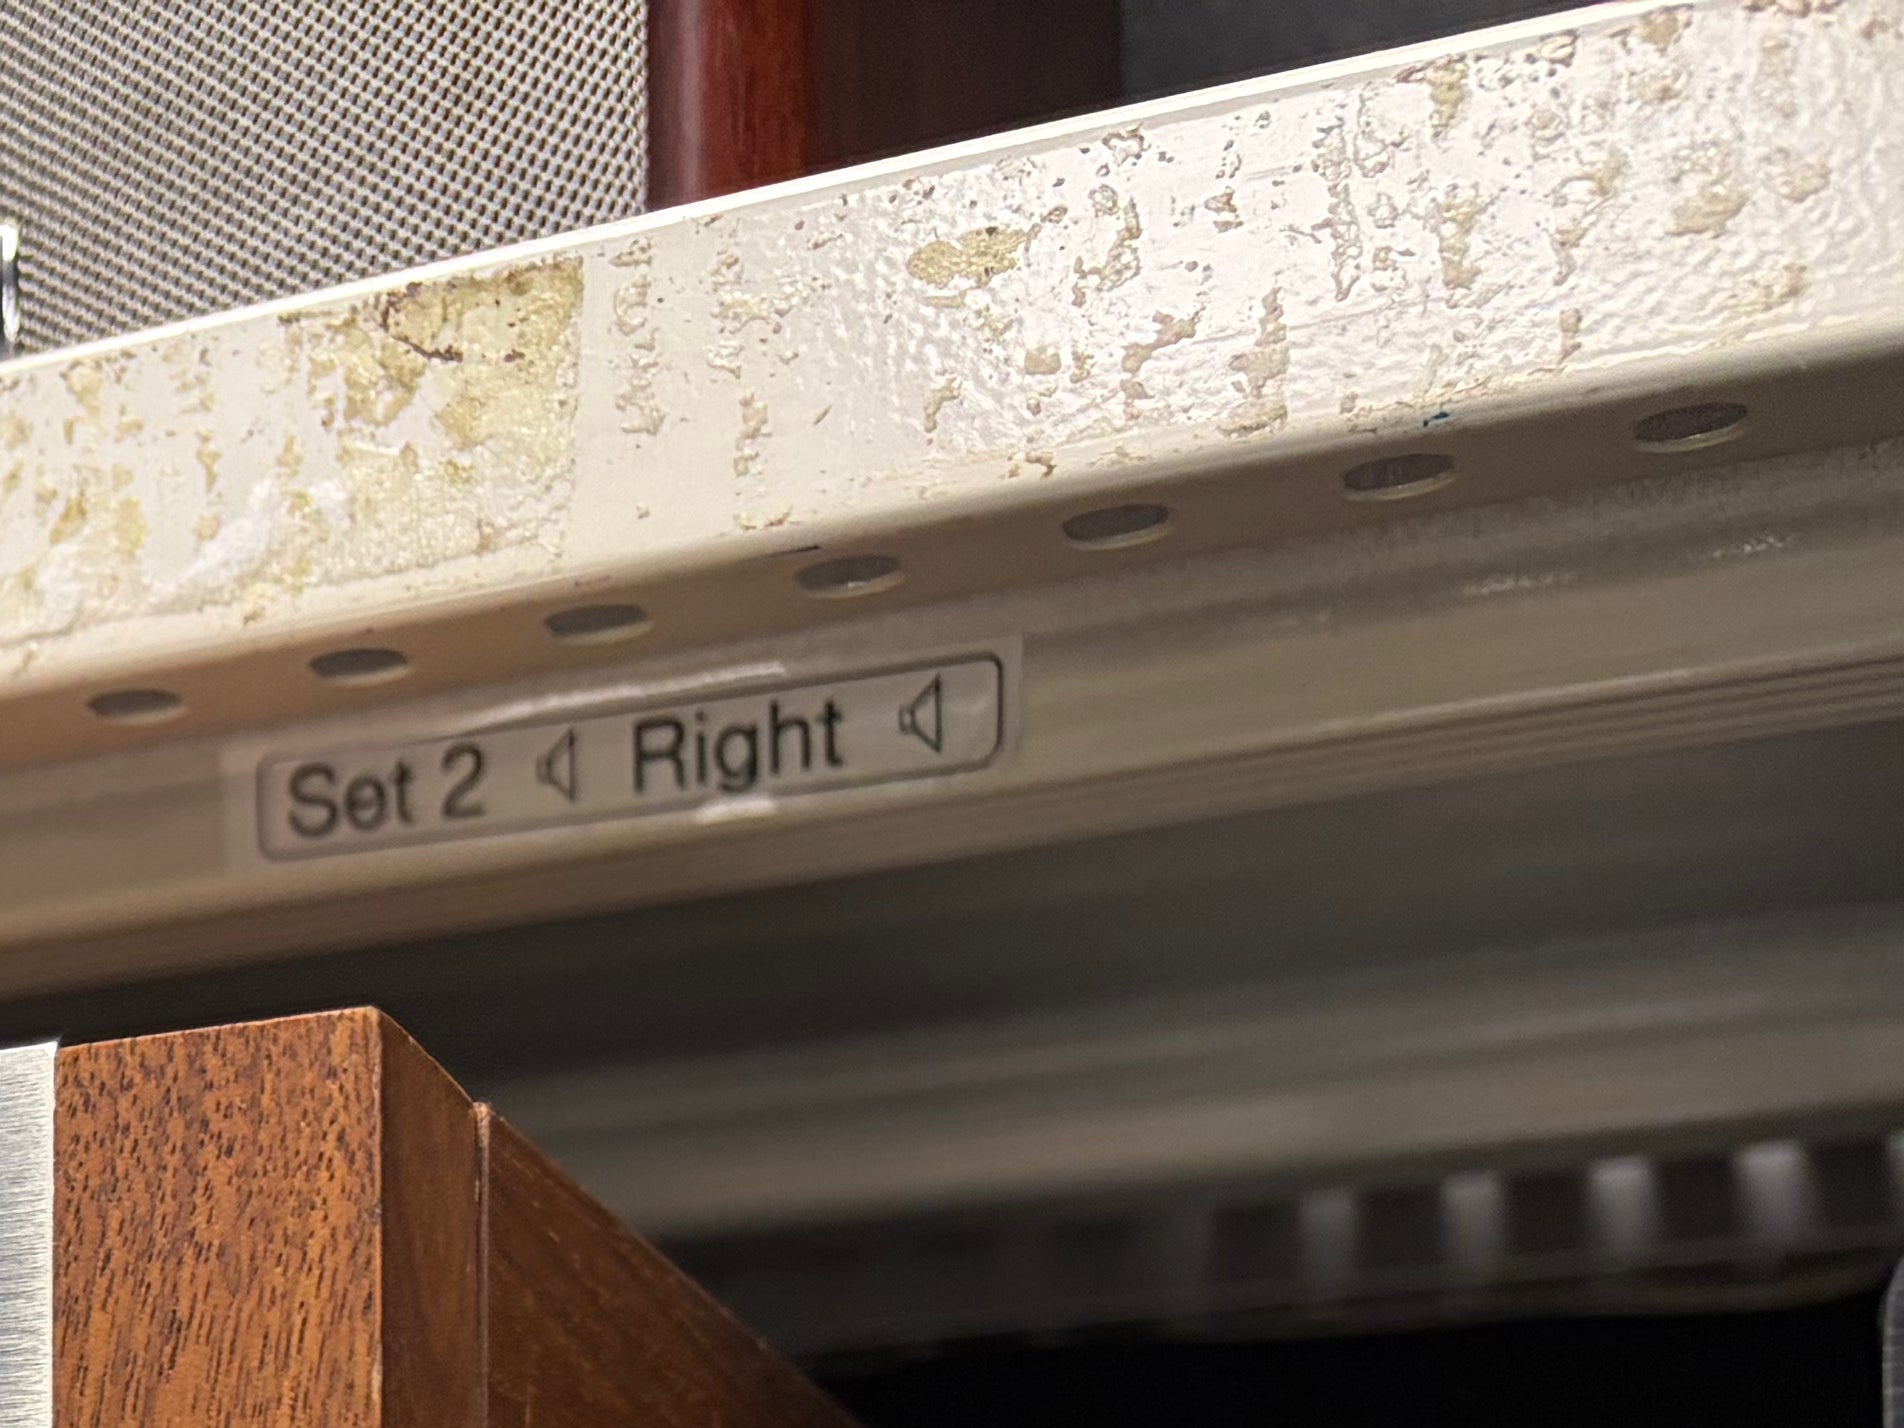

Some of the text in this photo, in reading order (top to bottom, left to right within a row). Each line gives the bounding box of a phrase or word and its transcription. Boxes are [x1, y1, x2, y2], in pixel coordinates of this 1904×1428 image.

[287, 698, 845, 840] Set 2 Right
